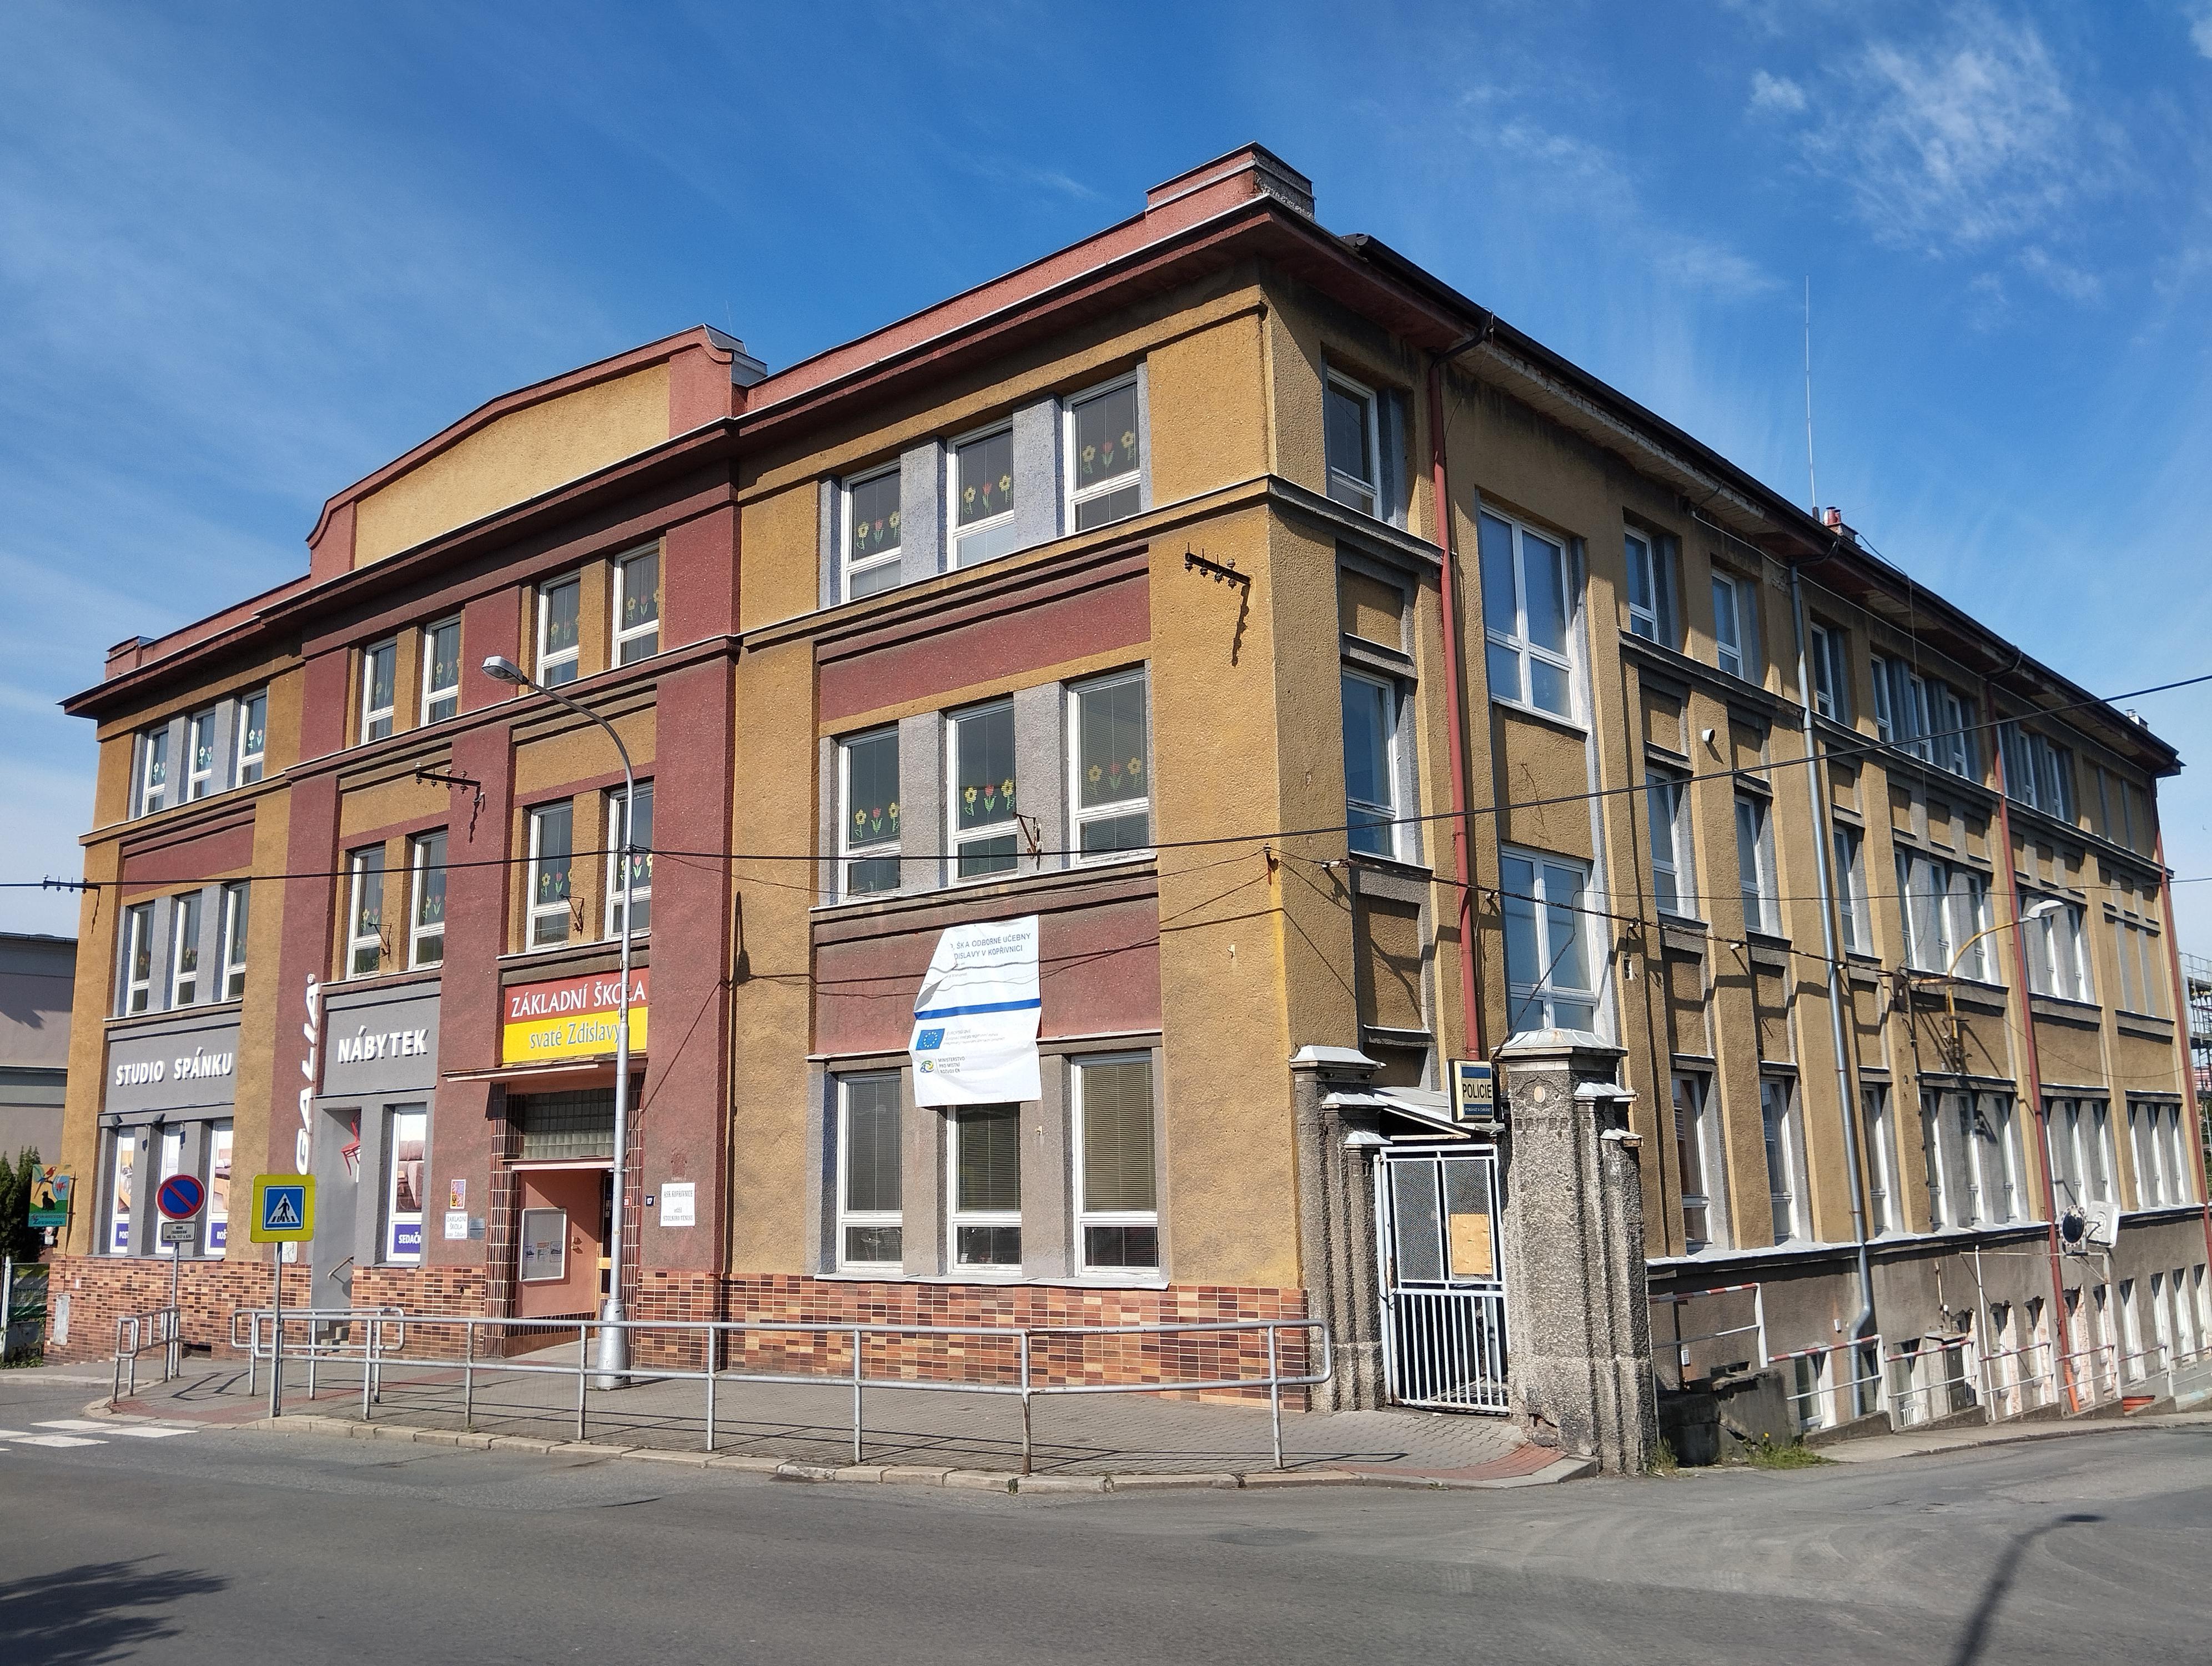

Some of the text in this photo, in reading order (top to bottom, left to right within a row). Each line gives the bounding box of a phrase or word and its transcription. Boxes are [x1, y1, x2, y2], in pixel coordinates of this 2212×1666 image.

[988, 944, 1023, 956] KOPŘIVNICI
[1003, 932, 1031, 943] UČEBNY
[511, 983, 589, 1017] ZÁKLADNÍ
[337, 1025, 429, 1063] NÁBYTEK
[529, 1020, 620, 1049] svaté Zdislavy
[115, 1045, 233, 1086] STUDIO SPÁNKU
[296, 982, 320, 1176] GALIA
[1462, 1083, 1492, 1098] POLICIE
